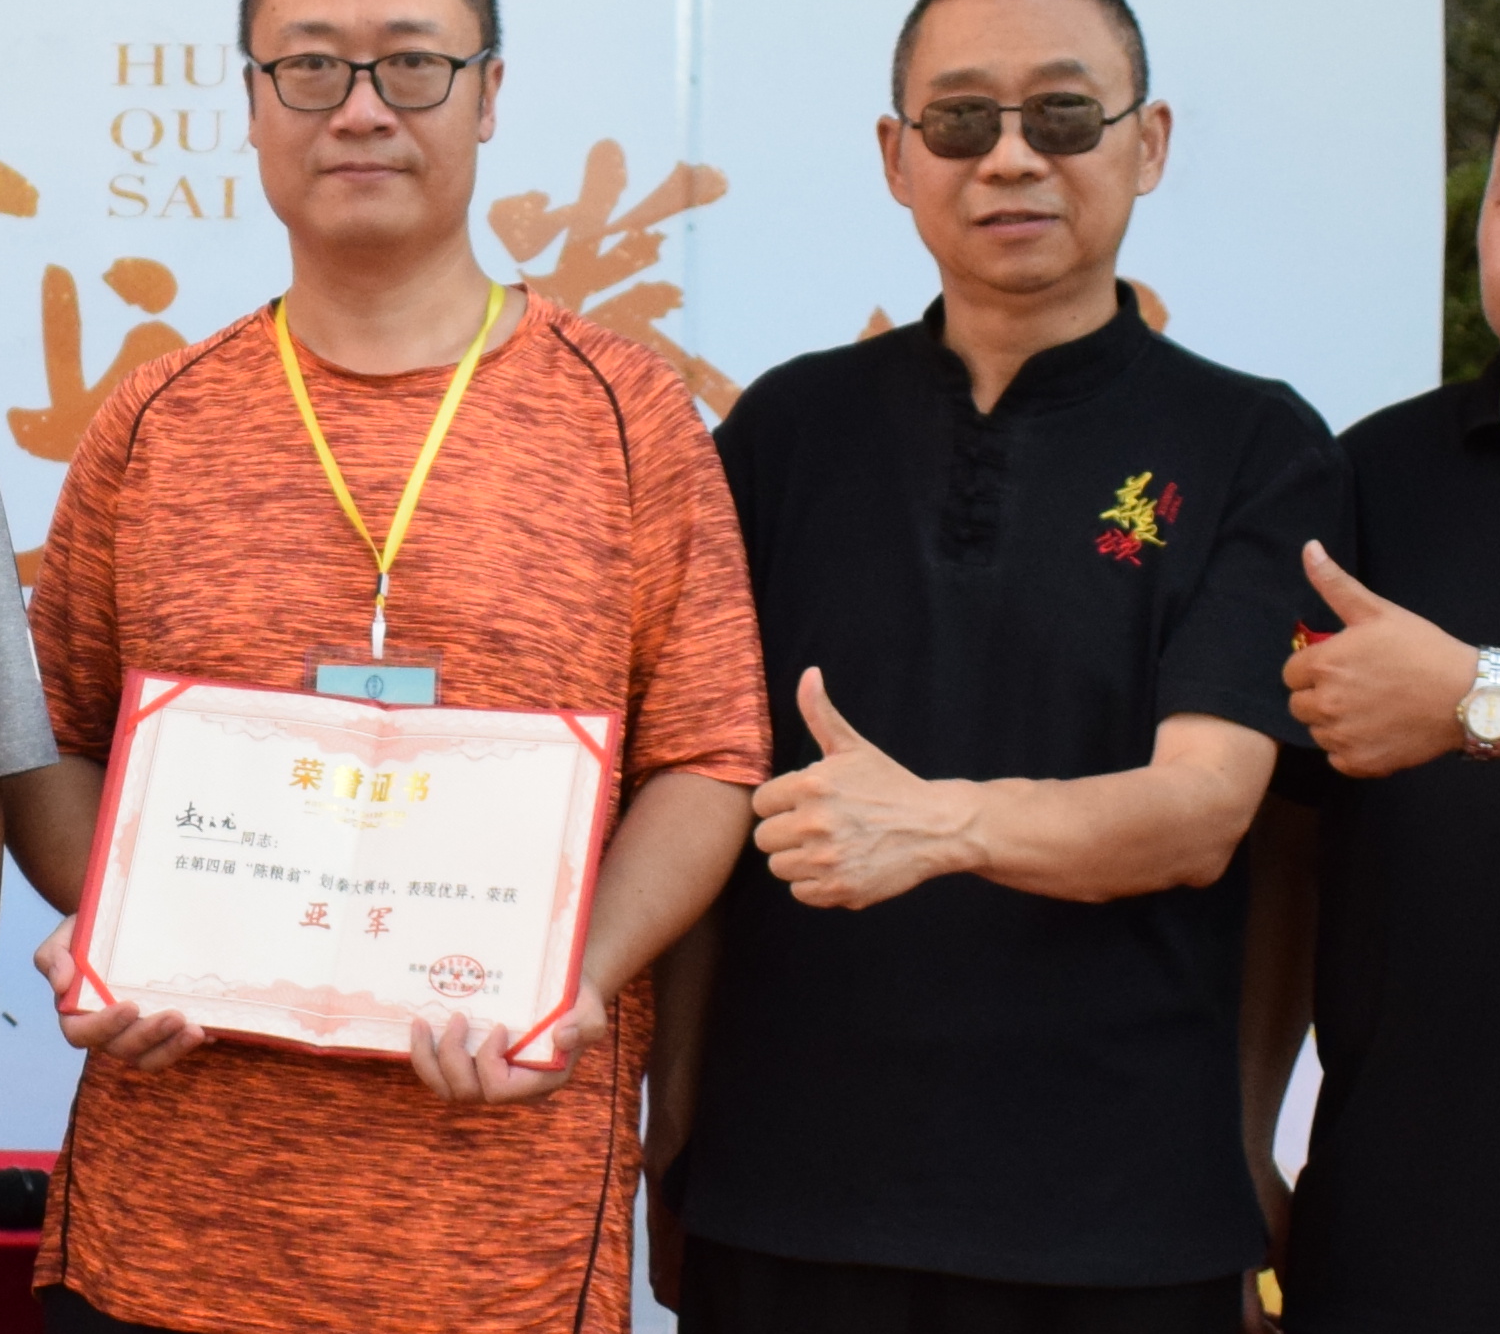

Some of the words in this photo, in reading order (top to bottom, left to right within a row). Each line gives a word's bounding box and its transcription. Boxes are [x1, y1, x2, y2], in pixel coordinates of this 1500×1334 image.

[111, 42, 245, 88] HU
[107, 173, 240, 219] SAI
[289, 756, 432, 804] 荣誉证书
[299, 901, 394, 939] 亚军
